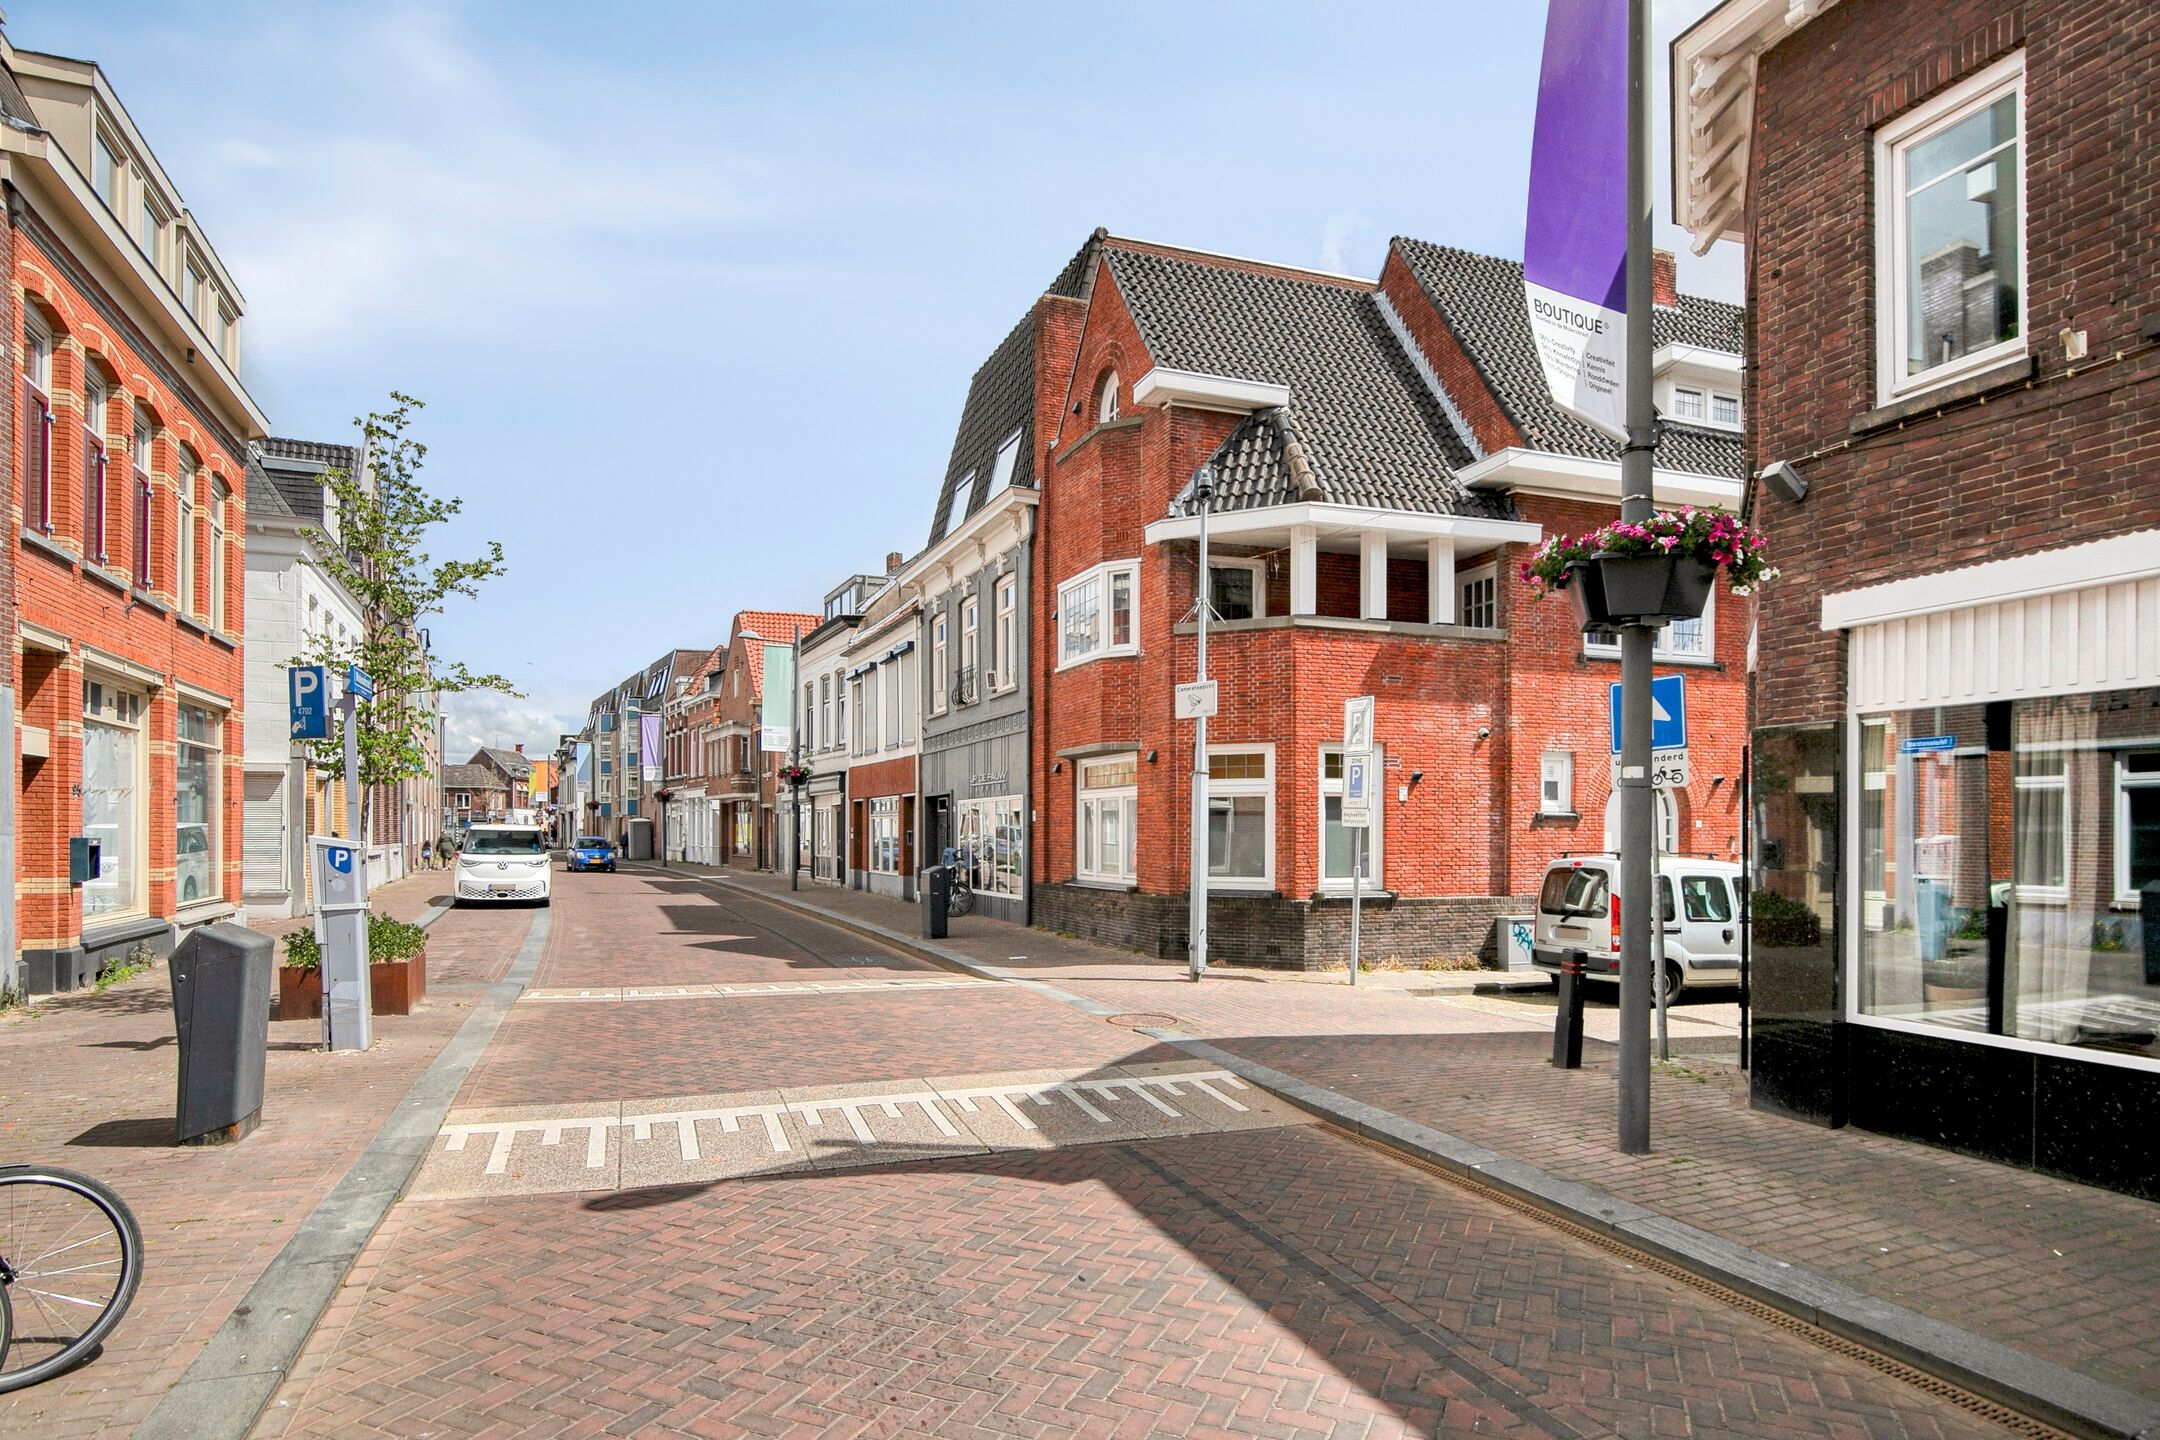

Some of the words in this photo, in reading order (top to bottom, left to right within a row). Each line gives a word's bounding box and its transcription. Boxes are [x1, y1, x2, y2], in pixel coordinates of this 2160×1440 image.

[1586, 361, 1606, 374] Kennis
[295, 670, 317, 707] P
[1352, 766, 1361, 785] P
[335, 850, 348, 867] P
